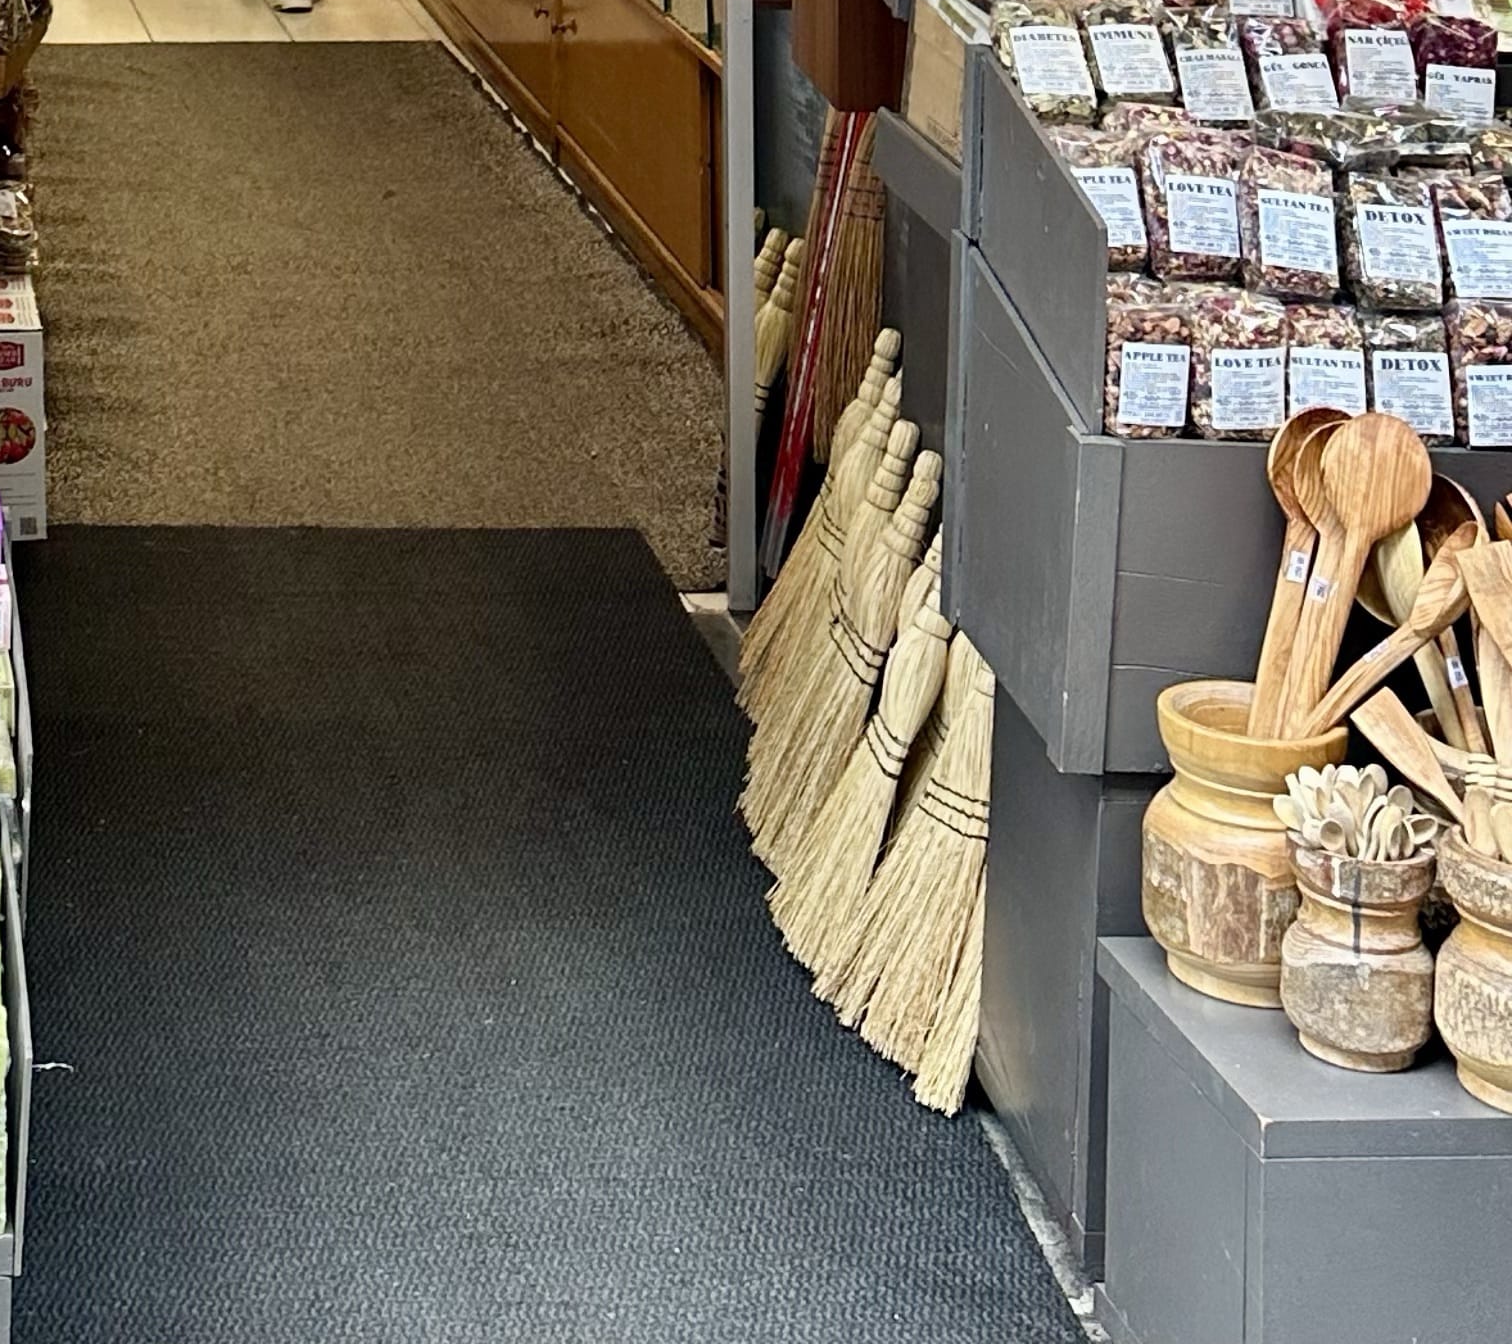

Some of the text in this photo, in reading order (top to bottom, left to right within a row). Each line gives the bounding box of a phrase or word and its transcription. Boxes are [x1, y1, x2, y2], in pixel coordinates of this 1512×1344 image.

[1093, 30, 1156, 41] IMMUNE
[1292, 61, 1328, 72] GONCA
[1111, 175, 1132, 185] TEA
[1168, 181, 1233, 198] LOVE TEA
[1261, 197, 1331, 213] SULTAN TEA
[1365, 210, 1427, 225] DETOX
[1125, 351, 1187, 363] APPLE TEA
[1215, 356, 1282, 368] LOVE TEA
[1291, 356, 1362, 370] SULTAN TEA
[1380, 358, 1442, 372] DETOX
